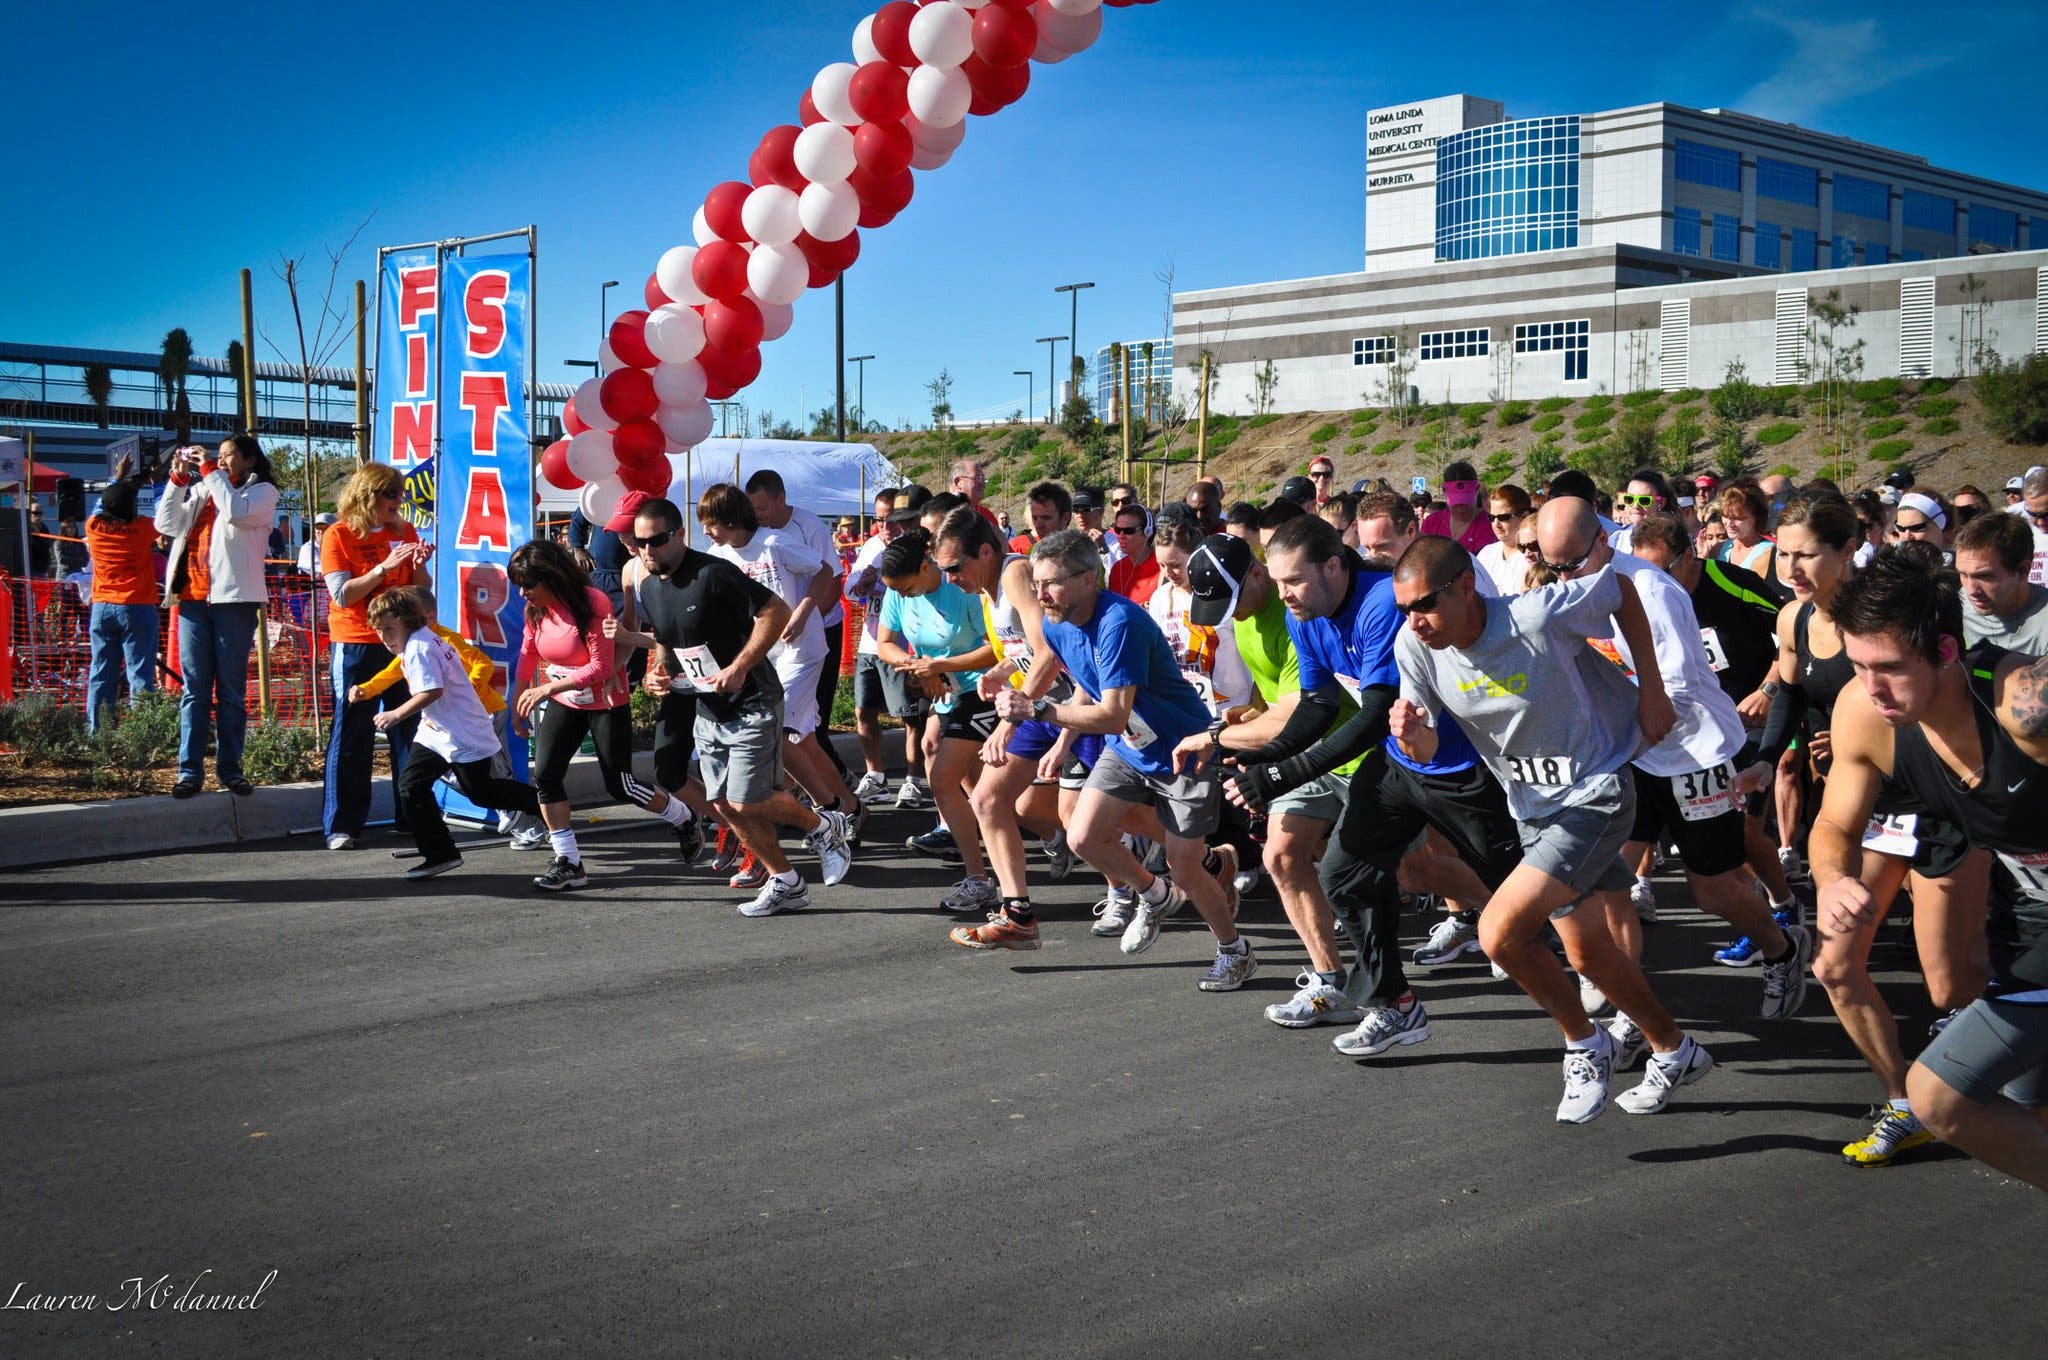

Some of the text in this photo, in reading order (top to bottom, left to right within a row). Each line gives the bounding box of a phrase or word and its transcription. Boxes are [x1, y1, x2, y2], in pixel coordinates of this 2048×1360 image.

[1369, 108, 1424, 125] LOMA LINDA
[1369, 124, 1423, 140] UNIVERSITY
[1368, 142, 1407, 156] MEDICAL
[1368, 173, 1414, 188] MURRIETA
[868, 596, 882, 614] 78
[685, 657, 706, 678] 37
[1267, 766, 1282, 781] 28
[1506, 756, 1561, 786] 318
[1679, 763, 1730, 800] 378
